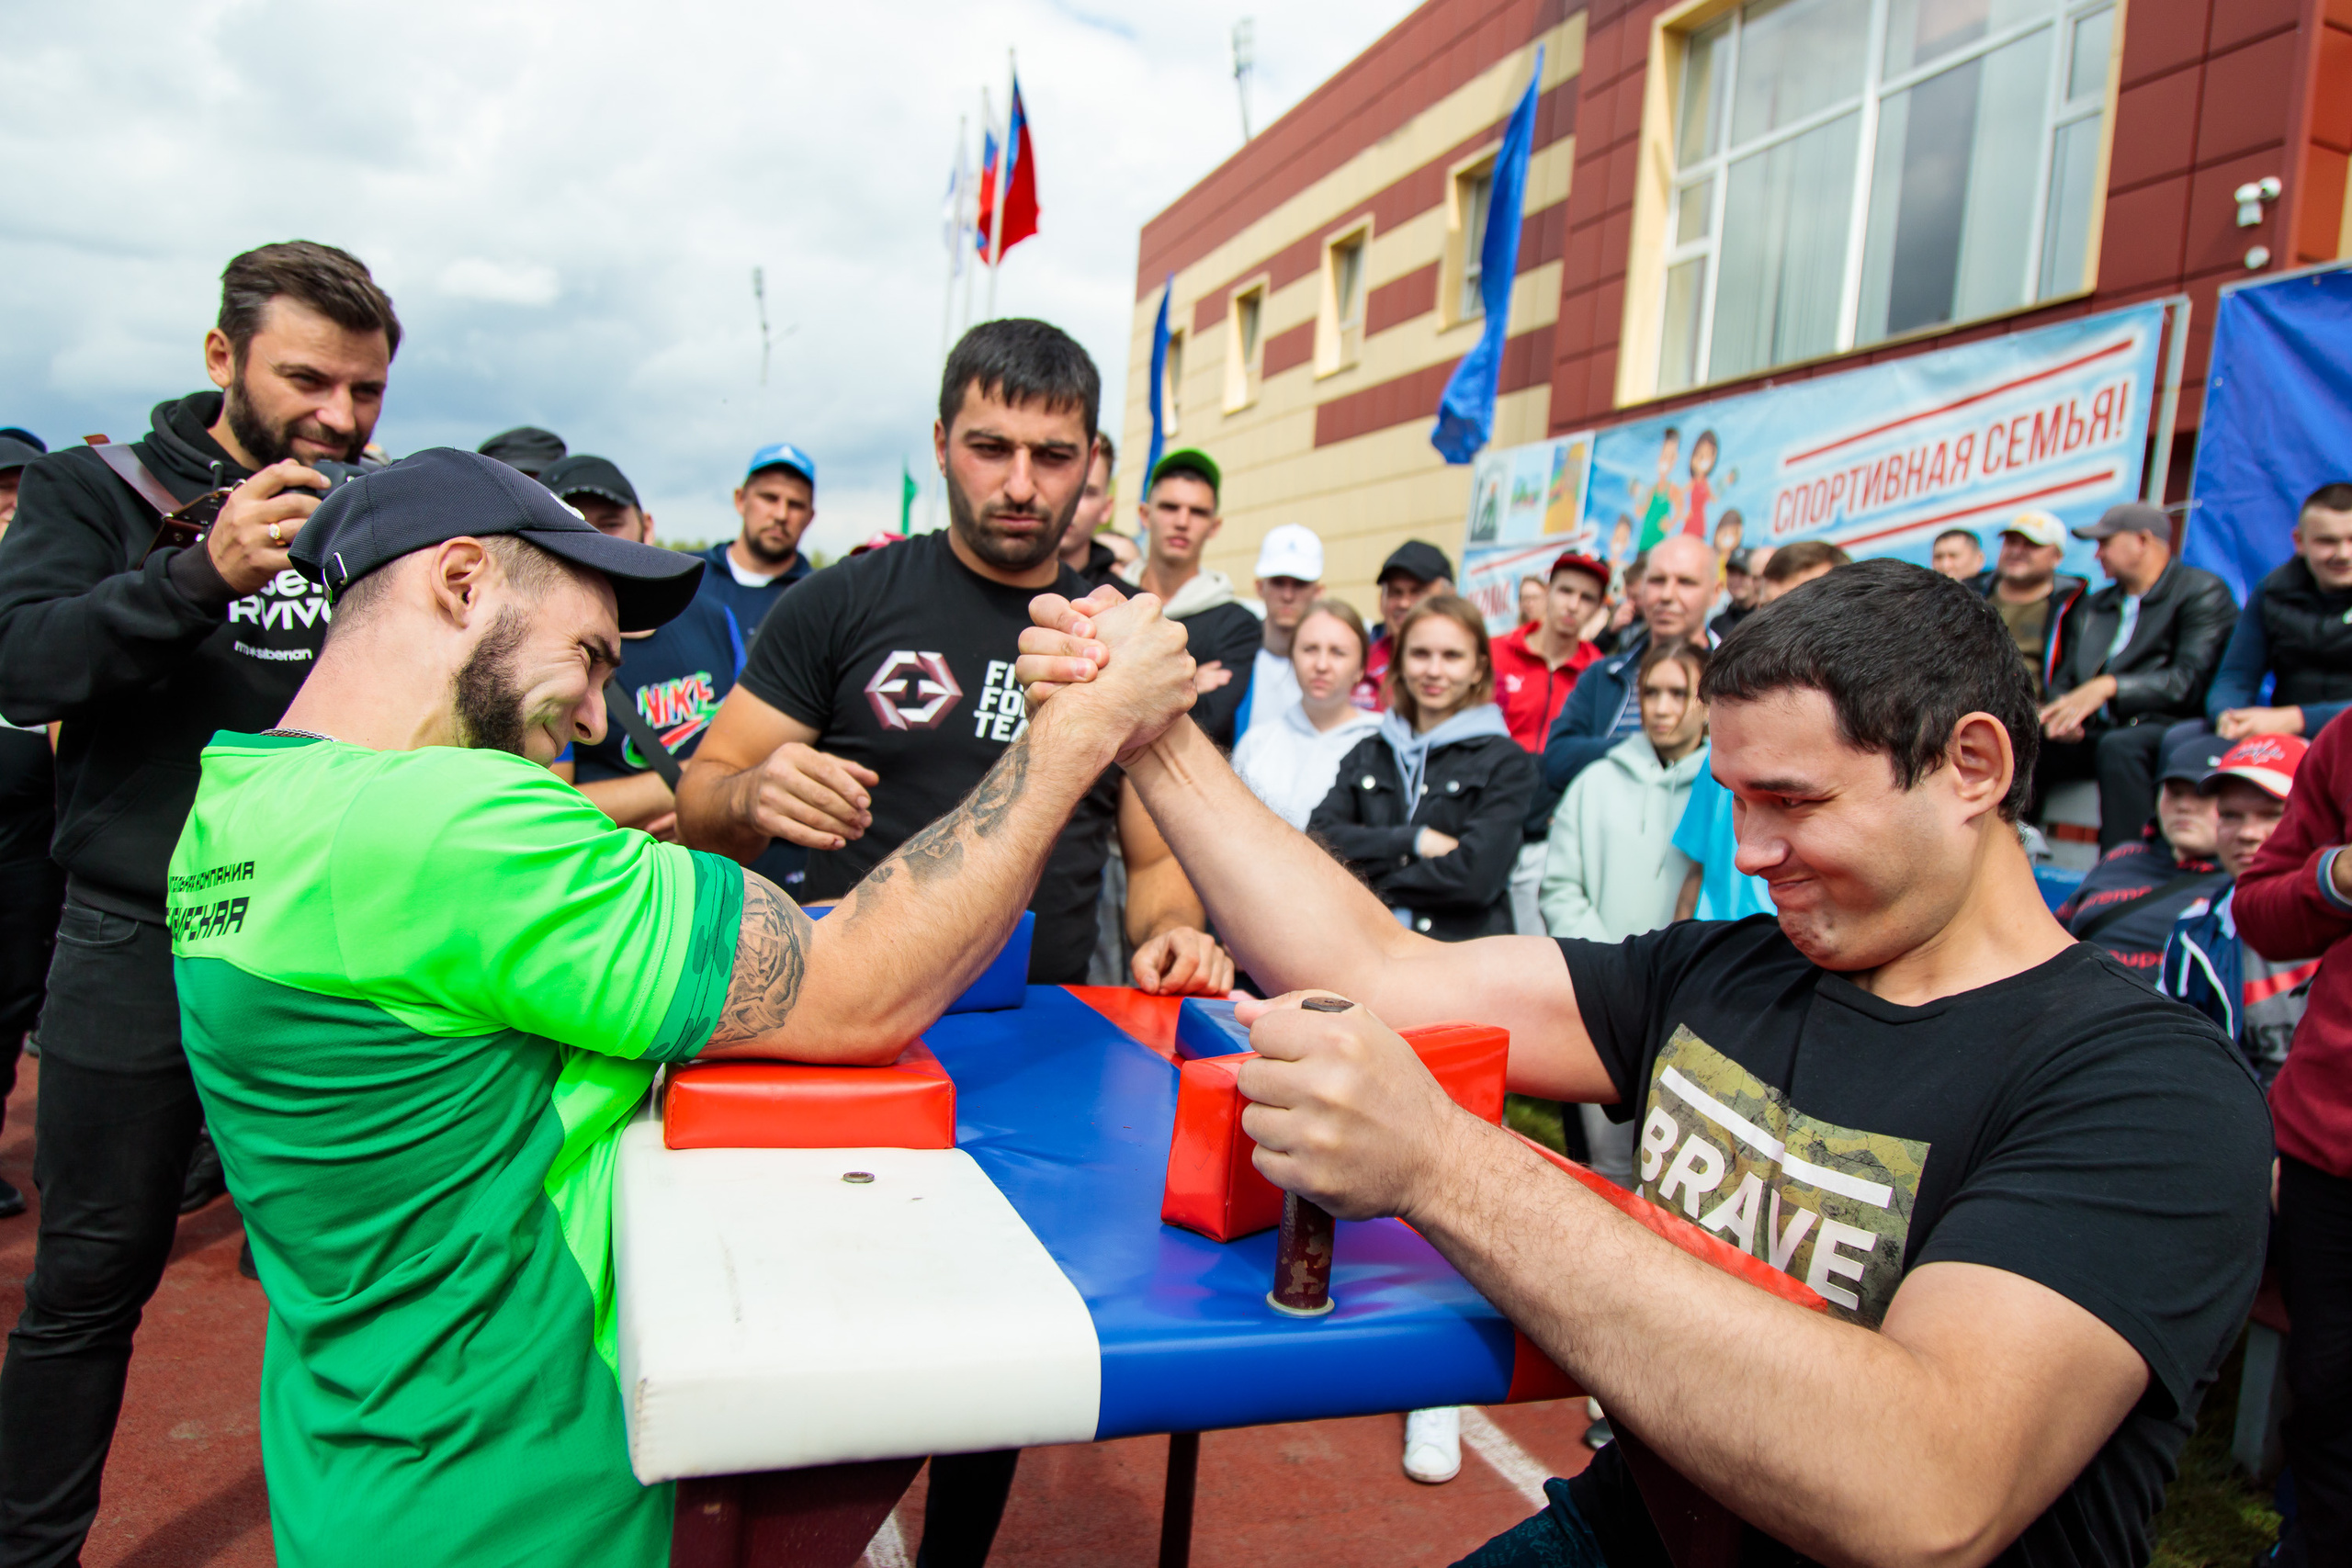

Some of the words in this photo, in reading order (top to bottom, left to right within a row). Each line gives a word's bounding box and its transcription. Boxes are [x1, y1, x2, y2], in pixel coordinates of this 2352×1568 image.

[1773, 432, 1975, 535] СПОРТИВНАЯ
[1982, 380, 2130, 475] СЕМЬЯ!
[636, 671, 717, 729] NIKE
[1641, 1105, 1878, 1311] BRAVE
